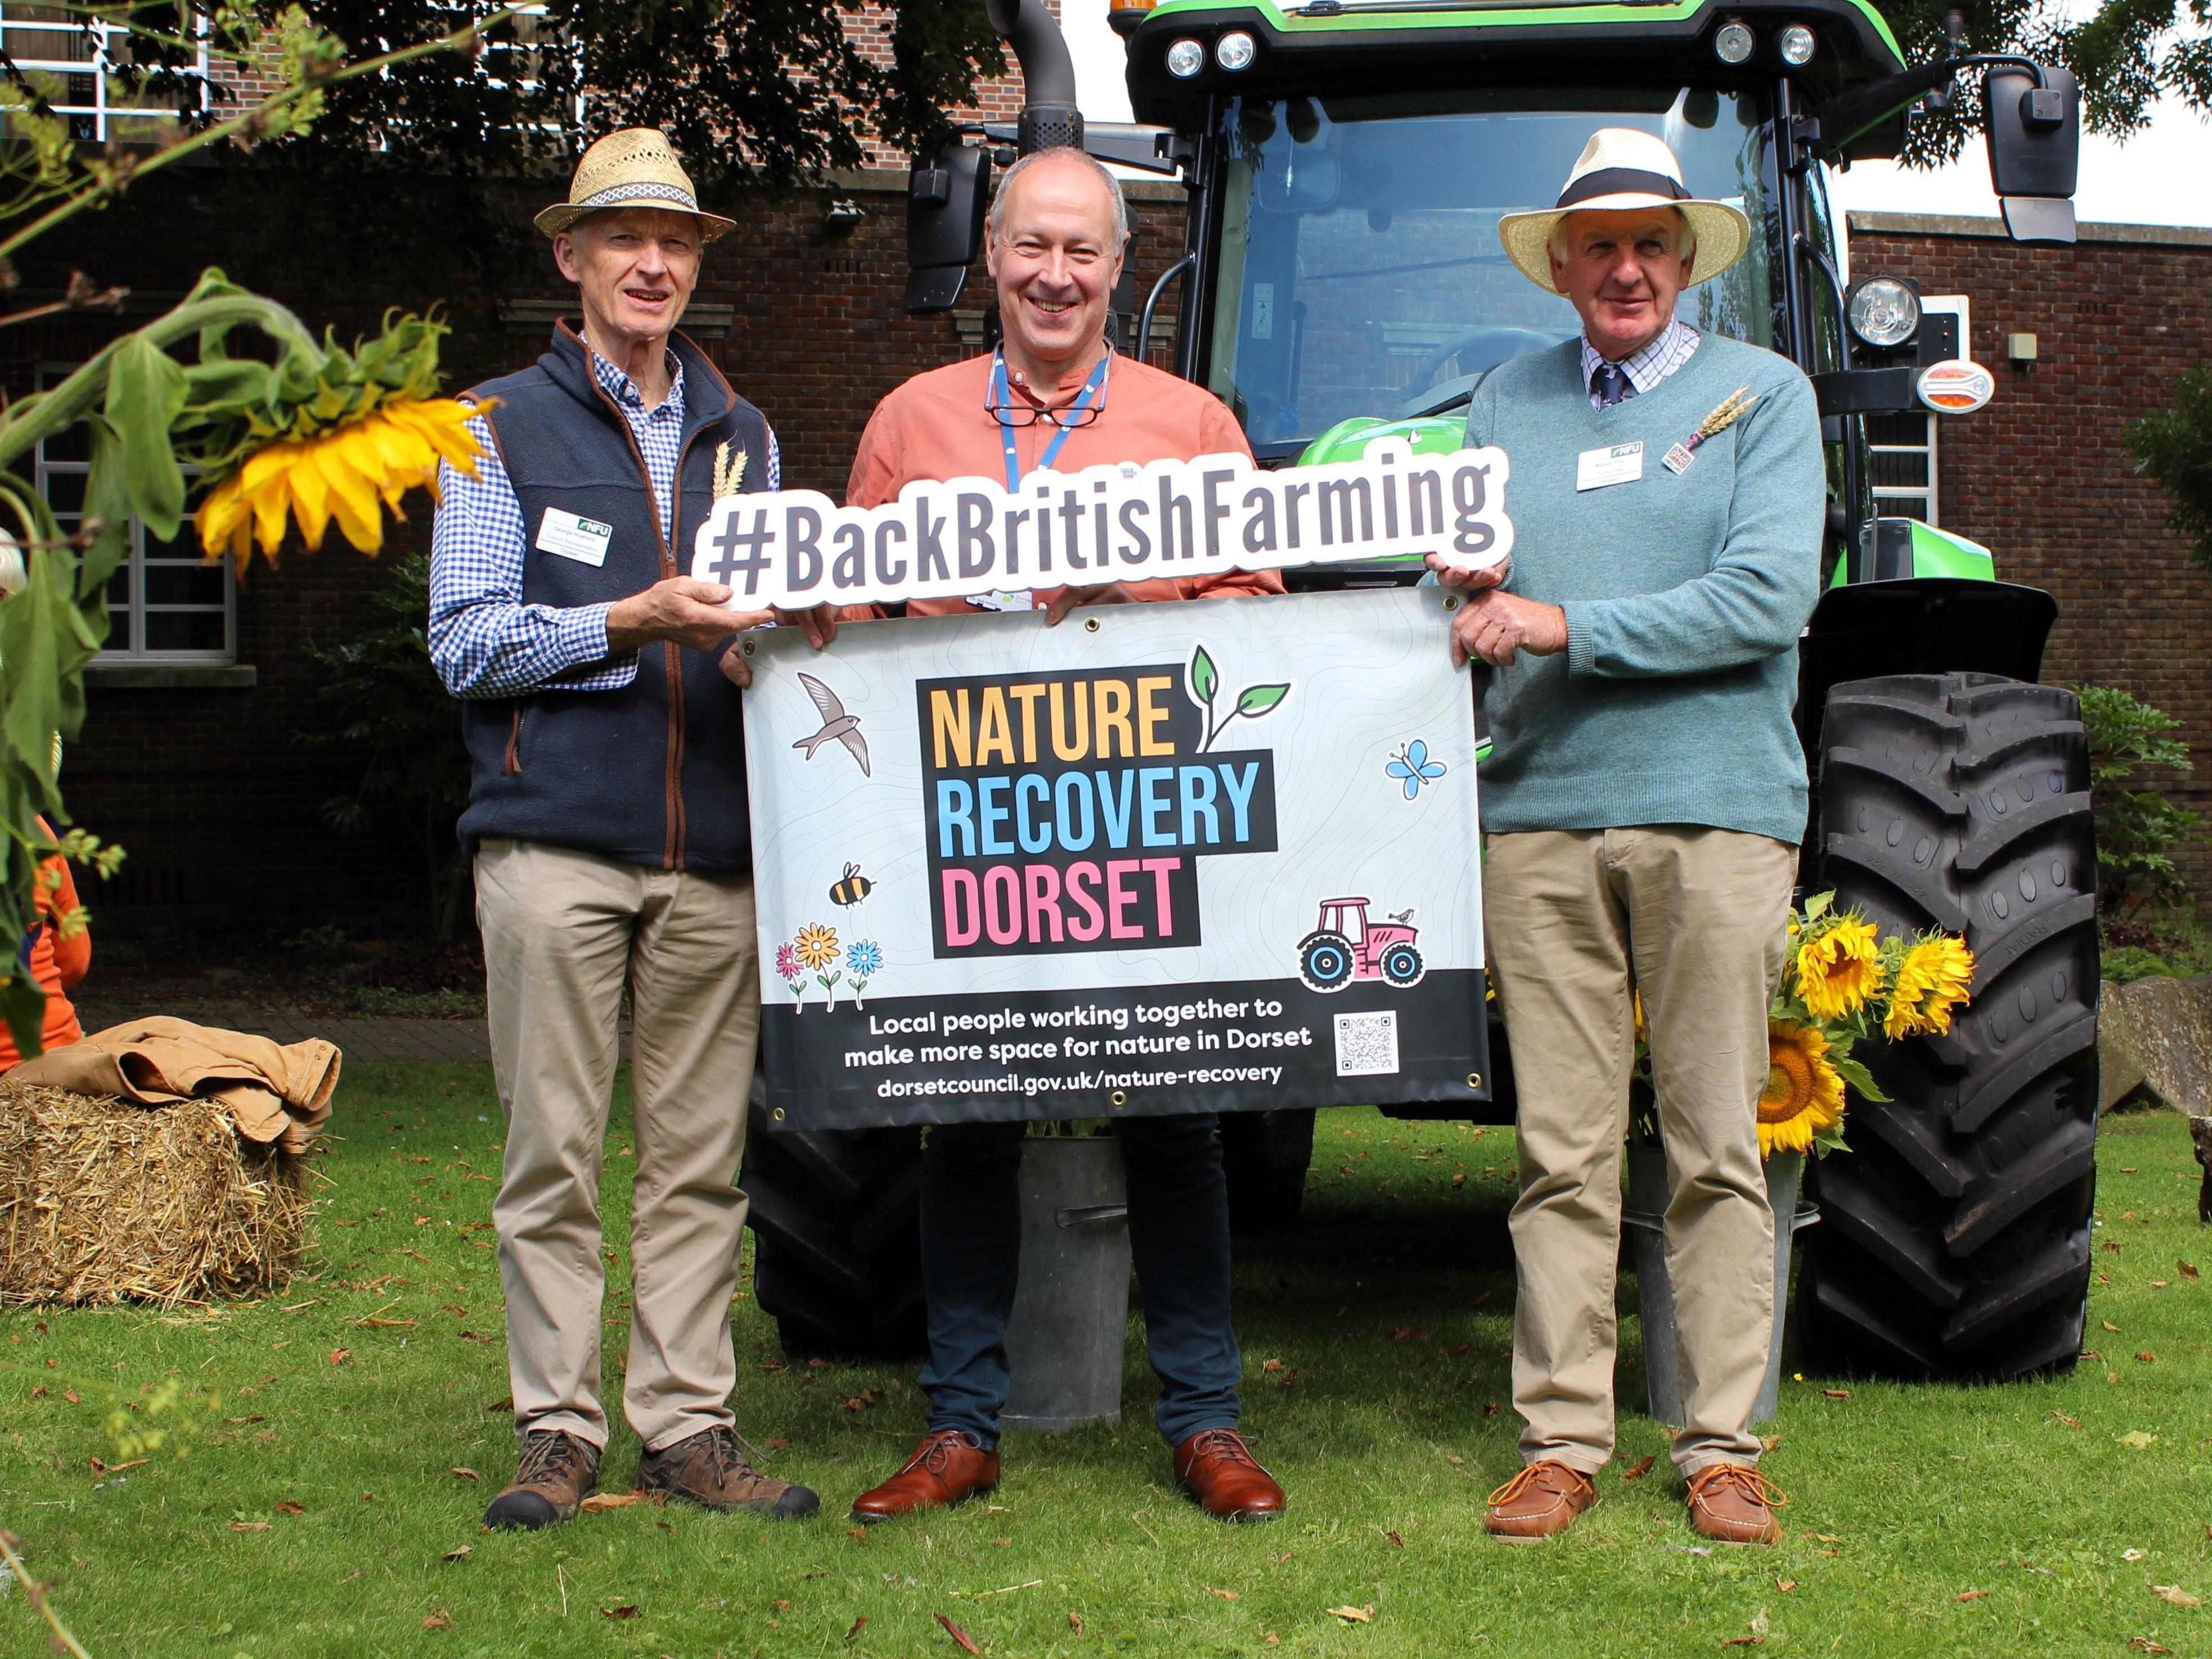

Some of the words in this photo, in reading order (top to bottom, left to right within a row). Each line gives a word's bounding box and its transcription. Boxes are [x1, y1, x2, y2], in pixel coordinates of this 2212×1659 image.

[1620, 444, 1640, 455] NFU
[587, 522, 608, 536] NFU
[708, 452, 1495, 595] #BackBritishFarming
[930, 676, 1175, 769] NATURE
[937, 762, 1260, 857] RECOVERY
[942, 857, 1181, 947] DORSET
[870, 1011, 937, 1035] Local
[943, 1008, 1026, 1036] people
[1030, 1004, 1129, 1030] working
[1134, 998, 1249, 1028] together
[1254, 998, 1283, 1018] to
[845, 1045, 914, 1068] make
[921, 1044, 983, 1063] more
[989, 1042, 1058, 1065] space
[1064, 1037, 1100, 1057] for
[1106, 1035, 1191, 1055] nature
[1197, 1029, 1220, 1050] in
[1227, 1027, 1313, 1049] Dorset
[877, 1066, 1282, 1098] dorsetcouncil.gov.uk/nature-recovery
